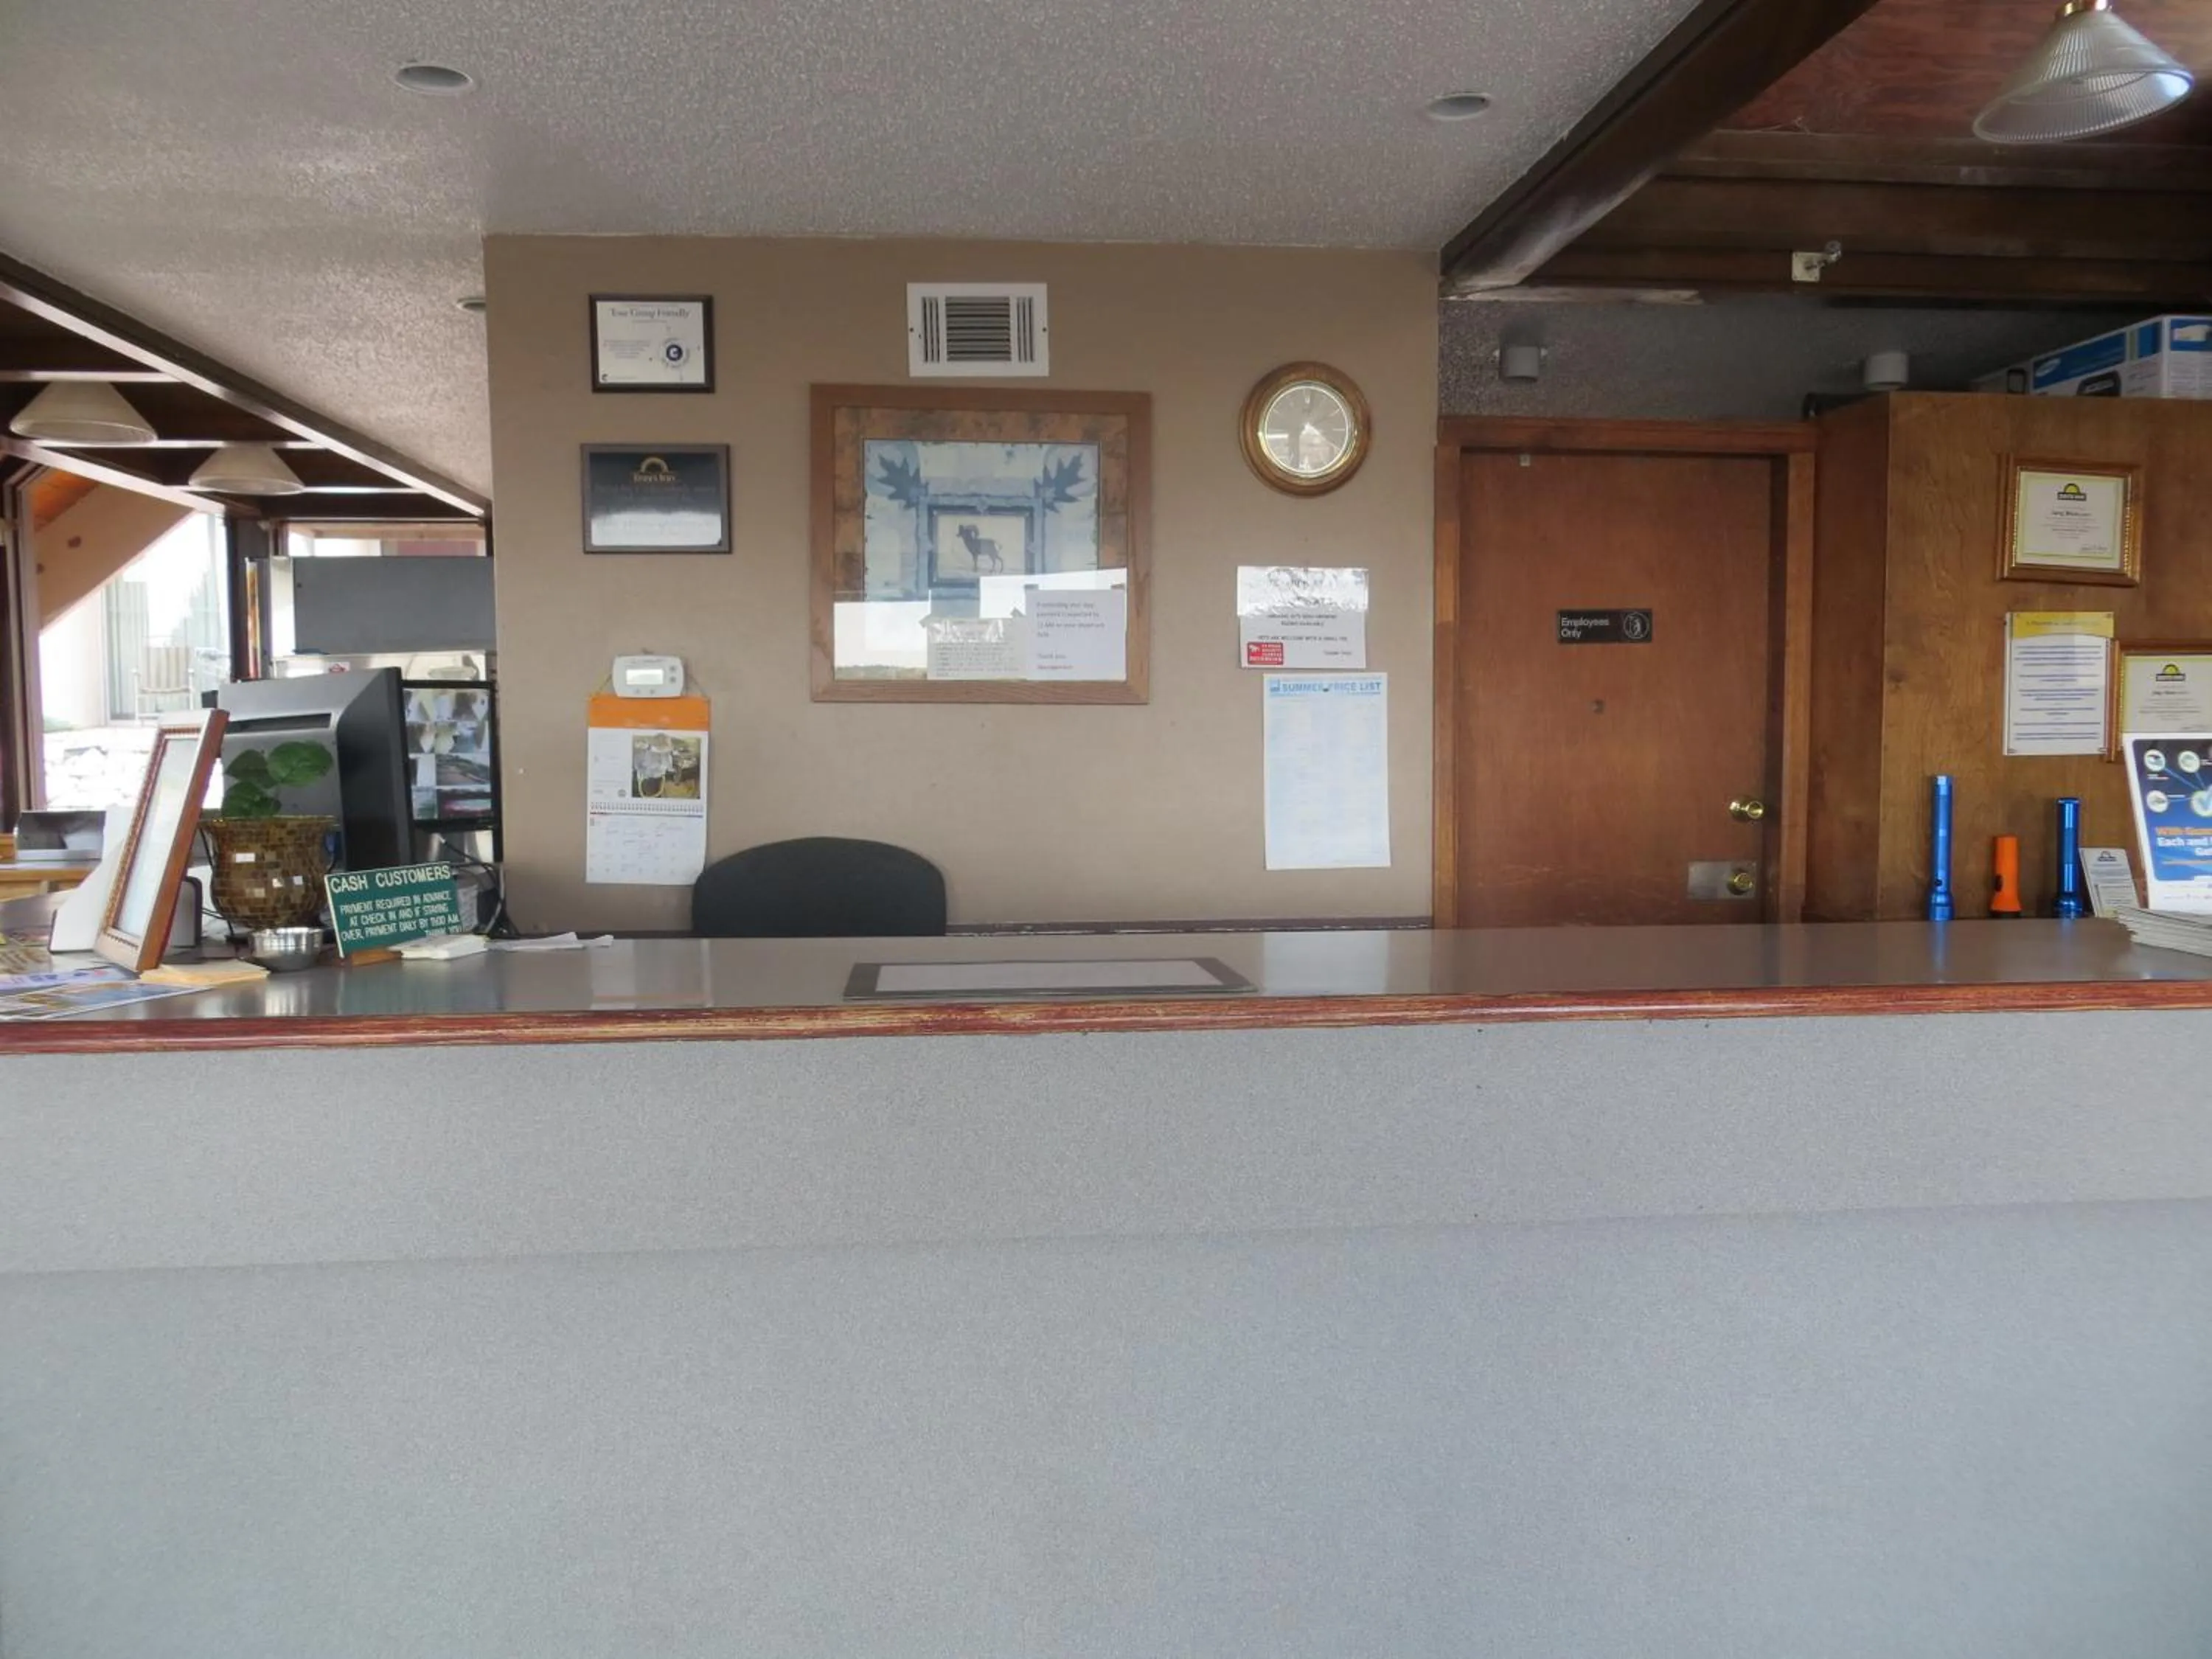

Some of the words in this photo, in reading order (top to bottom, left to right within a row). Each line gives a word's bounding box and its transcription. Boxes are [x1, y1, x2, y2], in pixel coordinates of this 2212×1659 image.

[1561, 617, 1610, 628] Employees
[1561, 627, 1582, 639] Only
[1360, 682, 1381, 691] LIST
[331, 874, 369, 894] CASH
[375, 865, 451, 888] CUSTOMERS
[339, 900, 373, 915] PAYMENT
[375, 896, 411, 911] REQUIRED
[361, 913, 386, 925] CHECK
[365, 923, 397, 938] PAYMENT
